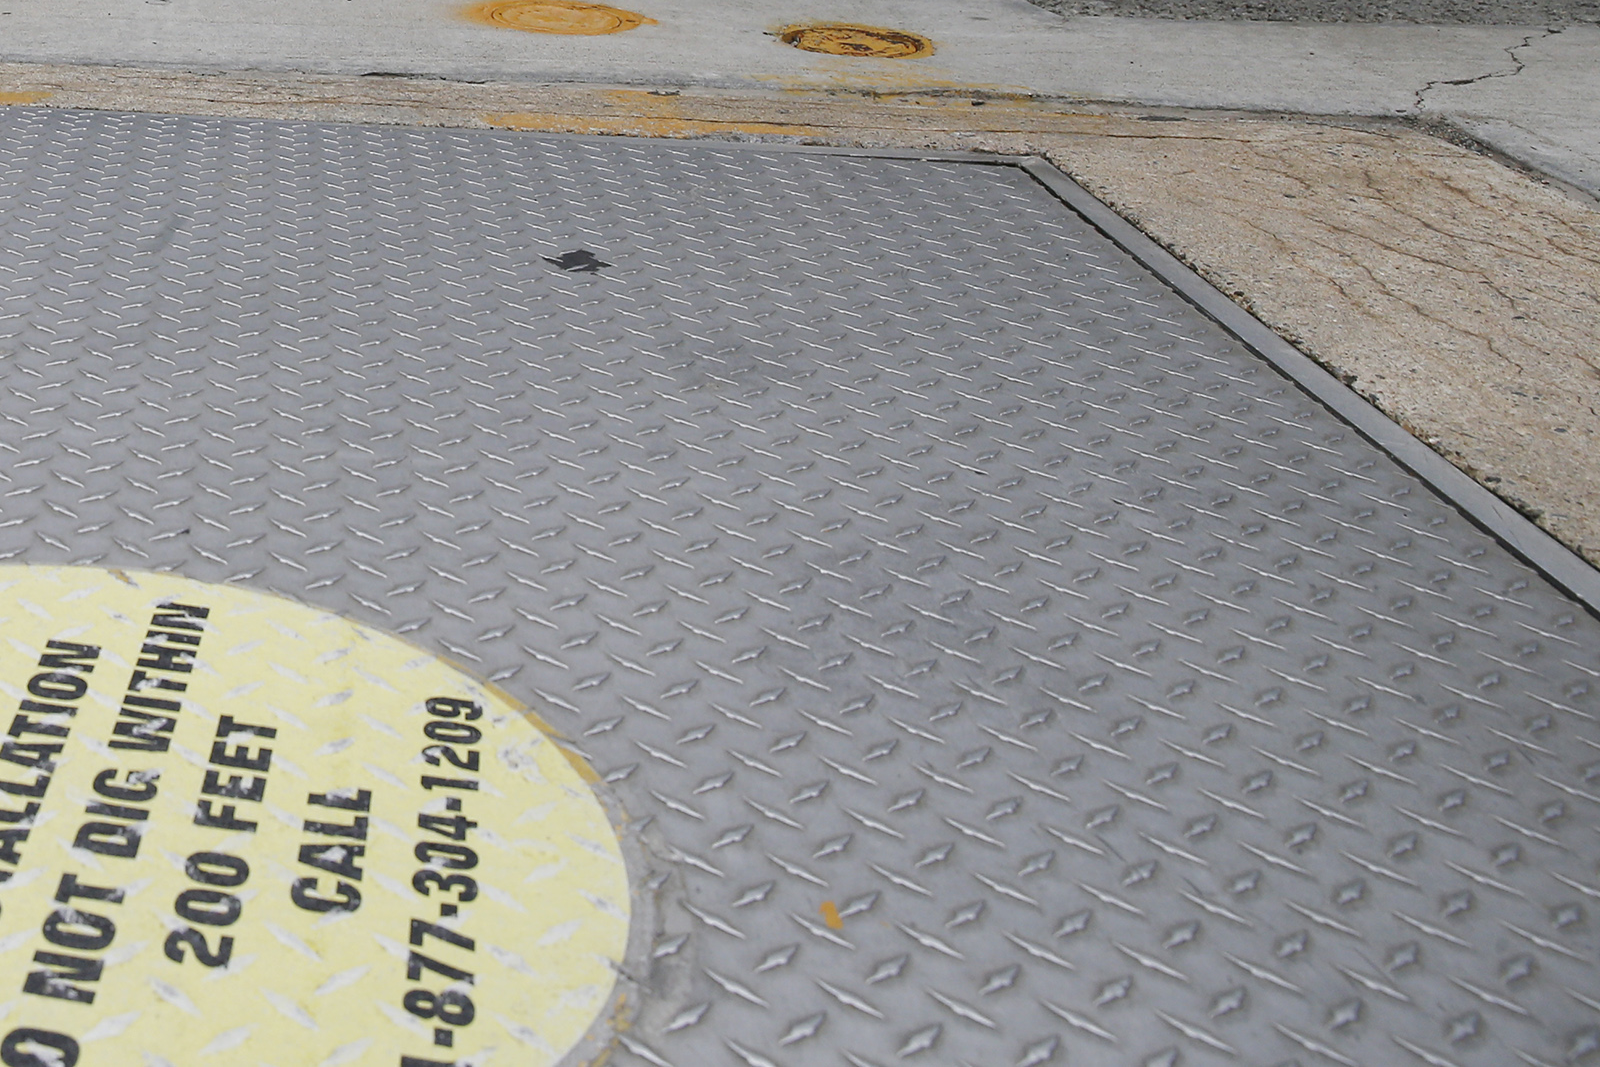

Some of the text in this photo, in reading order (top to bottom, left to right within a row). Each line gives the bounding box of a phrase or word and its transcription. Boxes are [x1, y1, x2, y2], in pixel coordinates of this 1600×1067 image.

[107, 601, 211, 754] WITHIN
[72, 768, 162, 859] DIG
[163, 714, 278, 970] 200 FEET
[290, 786, 372, 915] CALL
[22, 872, 127, 1005] NOT
